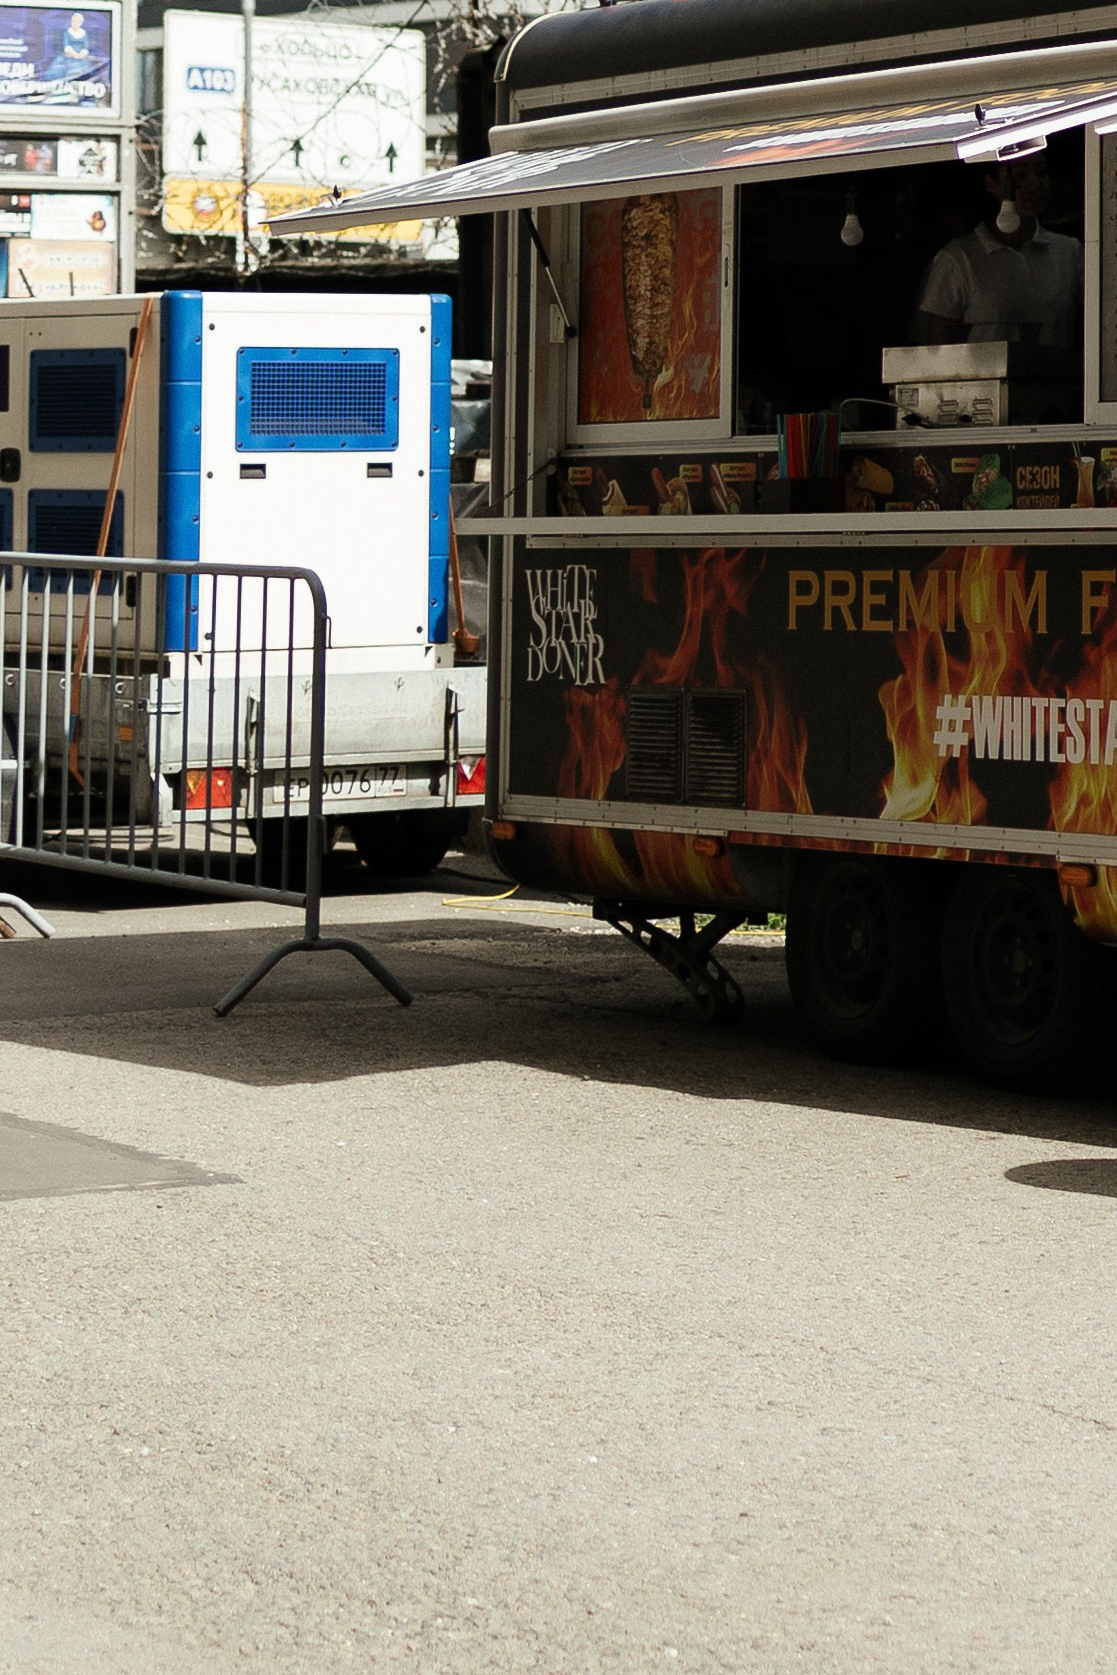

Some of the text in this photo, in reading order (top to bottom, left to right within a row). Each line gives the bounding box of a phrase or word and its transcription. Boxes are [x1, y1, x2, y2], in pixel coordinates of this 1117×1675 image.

[1016, 465, 1062, 491] СЕЗОН
[530, 595, 597, 649] STAR
[787, 569, 1047, 634] PREMIUM
[526, 633, 606, 686] DONER
[379, 767, 400, 786] 77
